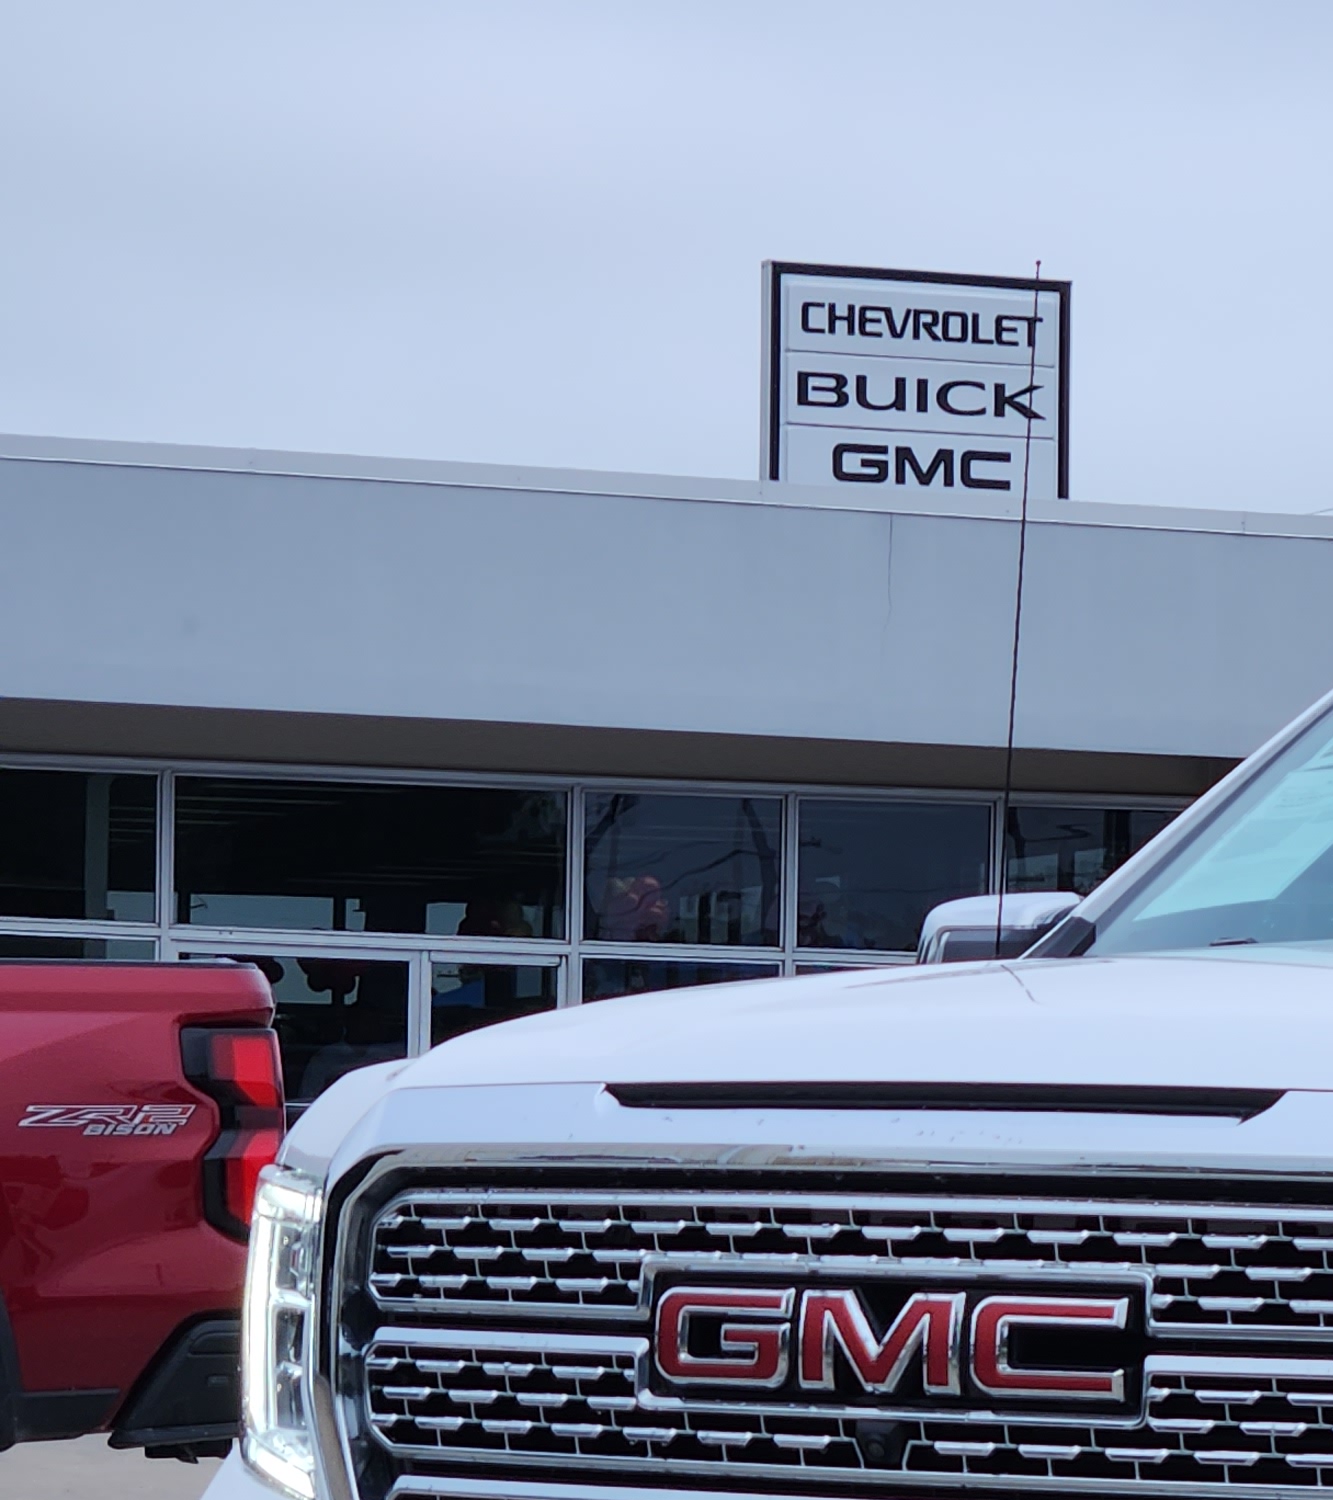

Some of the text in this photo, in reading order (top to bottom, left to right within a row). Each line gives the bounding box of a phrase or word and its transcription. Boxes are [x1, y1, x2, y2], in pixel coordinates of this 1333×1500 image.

[801, 301, 1043, 348] CHEVROLET
[797, 371, 1046, 421] BUICK
[832, 443, 1012, 491] GMC
[18, 1104, 196, 1127] ZR2
[82, 1123, 178, 1136] BISON
[654, 1286, 1130, 1402] GMC
